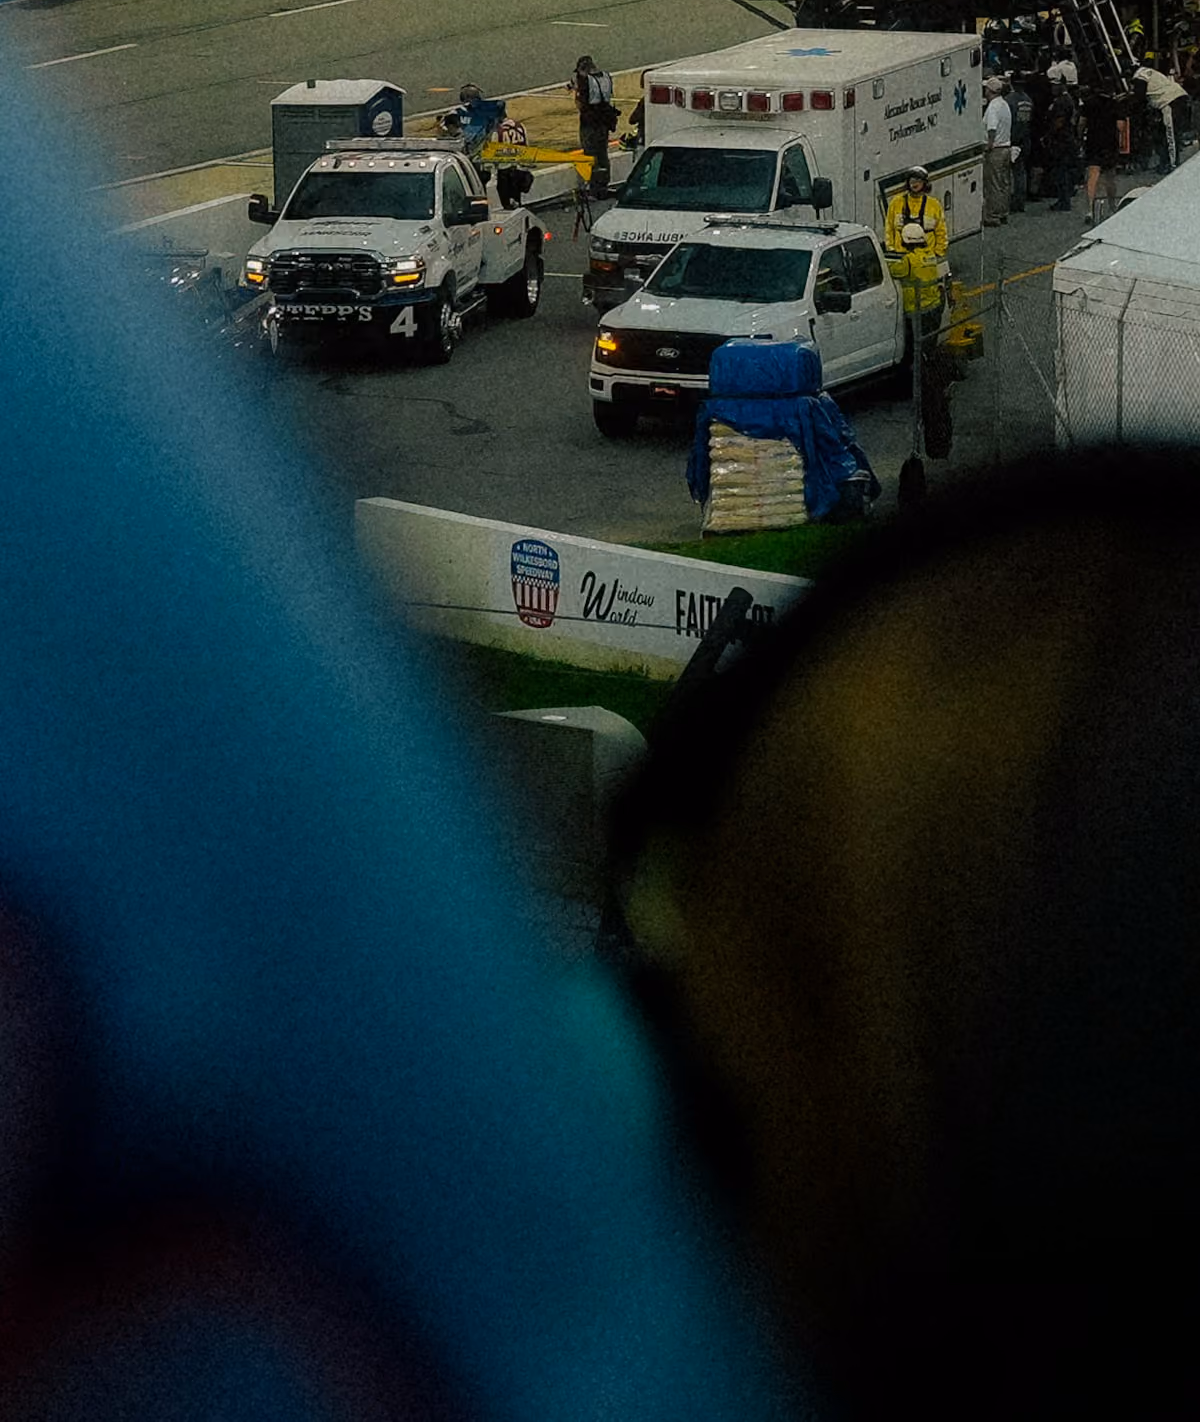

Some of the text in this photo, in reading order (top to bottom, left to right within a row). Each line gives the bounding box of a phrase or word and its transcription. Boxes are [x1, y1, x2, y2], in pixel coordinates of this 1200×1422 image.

[389, 305, 418, 338] 4
[522, 542, 548, 556] NORTH
[516, 564, 554, 581] SPEEDWAY
